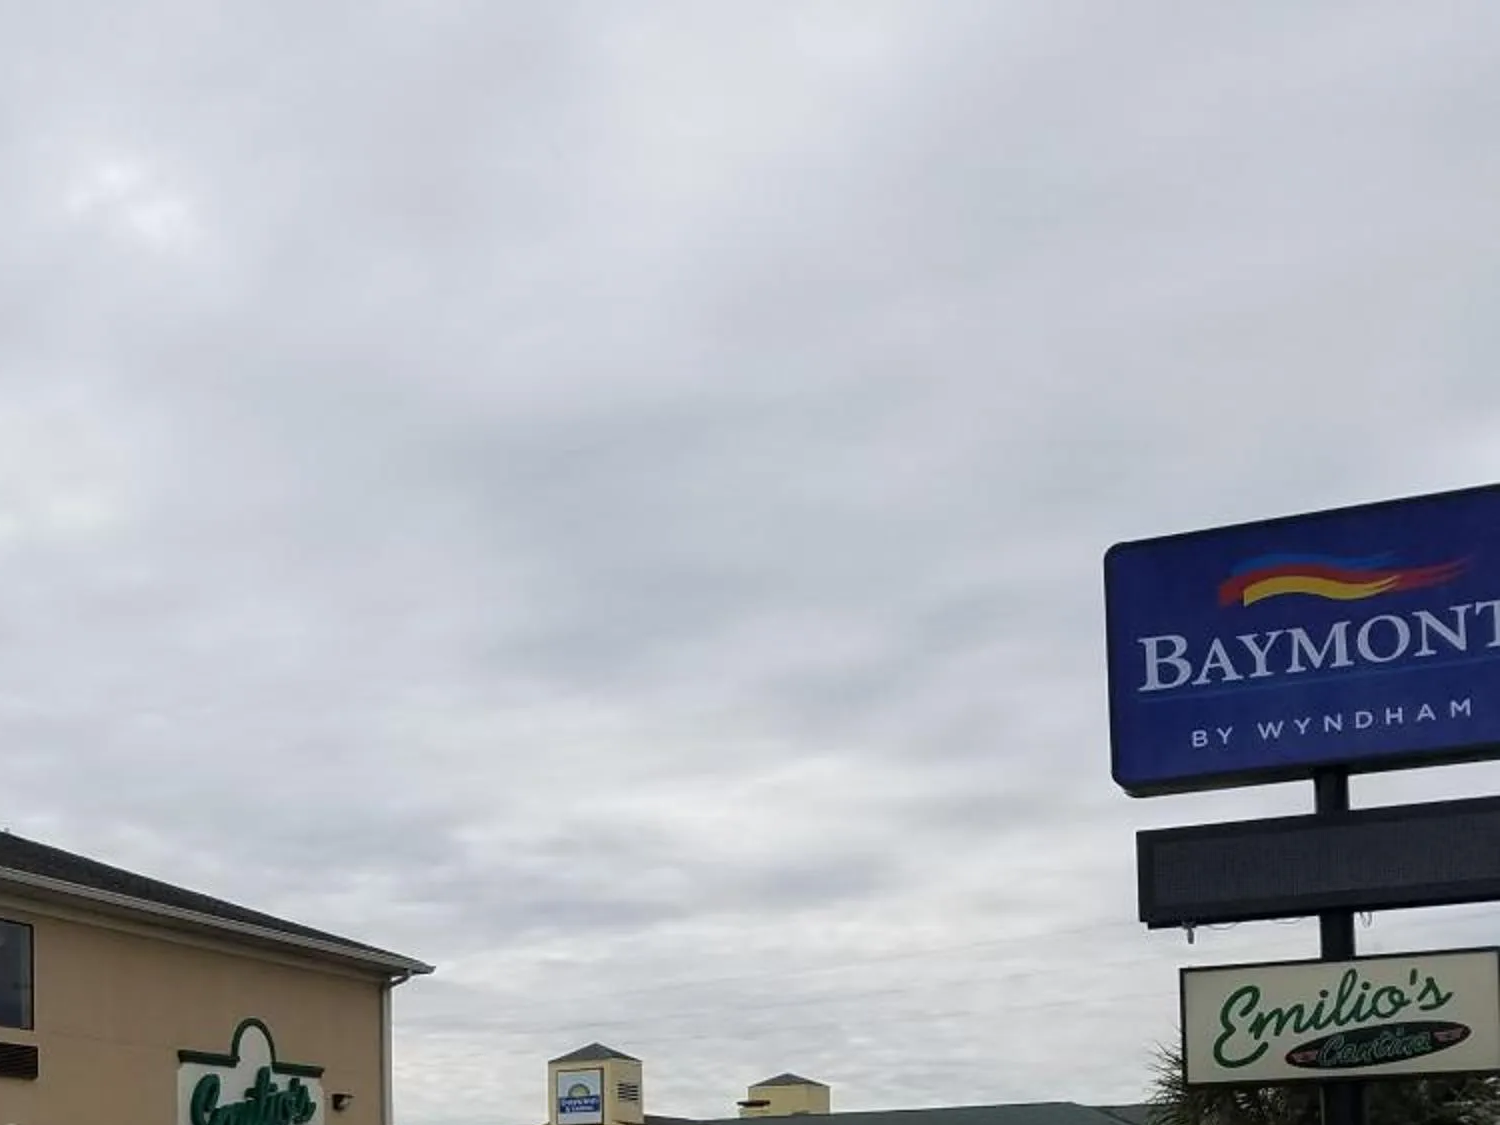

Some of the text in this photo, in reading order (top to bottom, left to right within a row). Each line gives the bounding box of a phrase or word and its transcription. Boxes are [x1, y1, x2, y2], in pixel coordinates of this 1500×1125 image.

[1137, 600, 1500, 692] BAYMONT
[1192, 698, 1473, 748] BY WYNDHAM
[1213, 968, 1453, 1068] Emilio's
